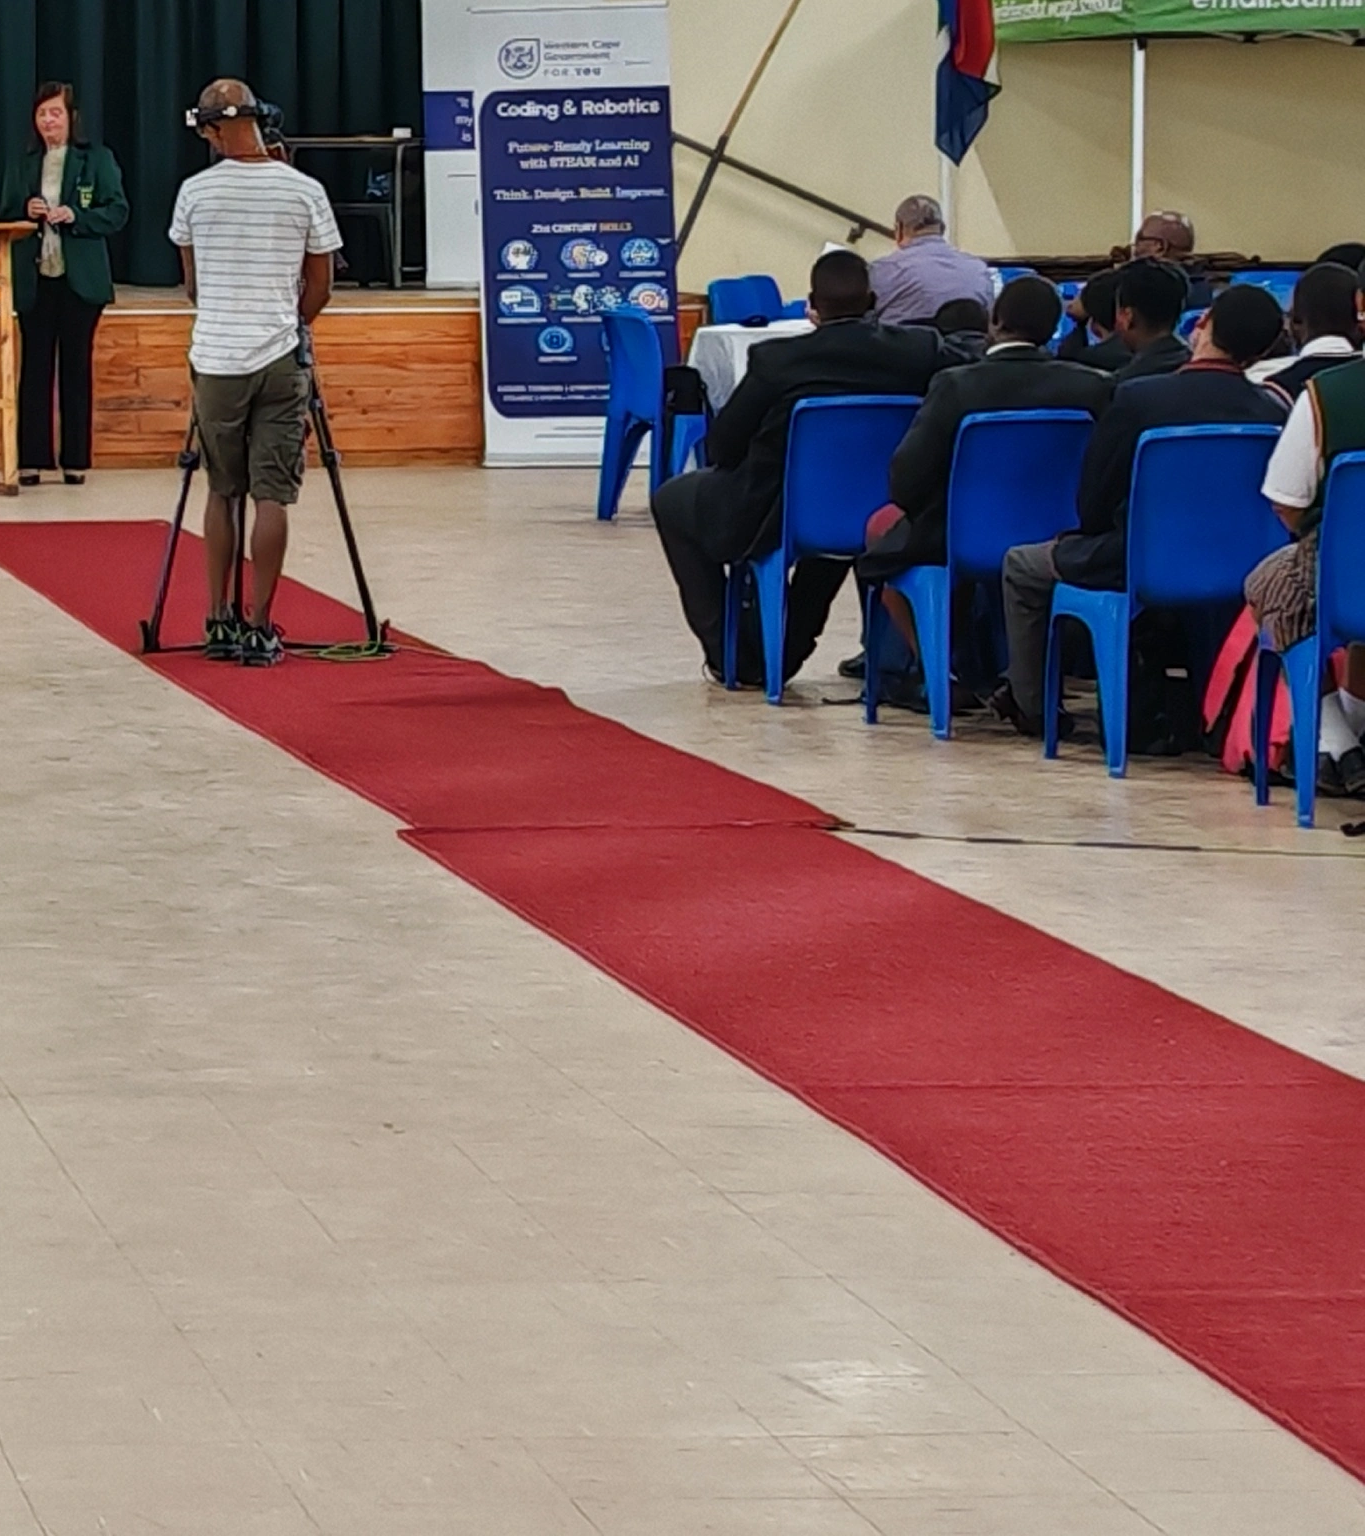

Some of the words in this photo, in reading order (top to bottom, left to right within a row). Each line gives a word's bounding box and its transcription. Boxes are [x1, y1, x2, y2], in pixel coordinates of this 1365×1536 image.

[543, 68, 569, 77] FOR
[496, 100, 560, 122] Coding
[562, 99, 577, 116] &
[581, 97, 662, 115] Robotics
[507, 139, 593, 154] Future-Ready
[595, 138, 651, 153] Learning
[519, 156, 548, 170] with
[598, 155, 622, 168] and
